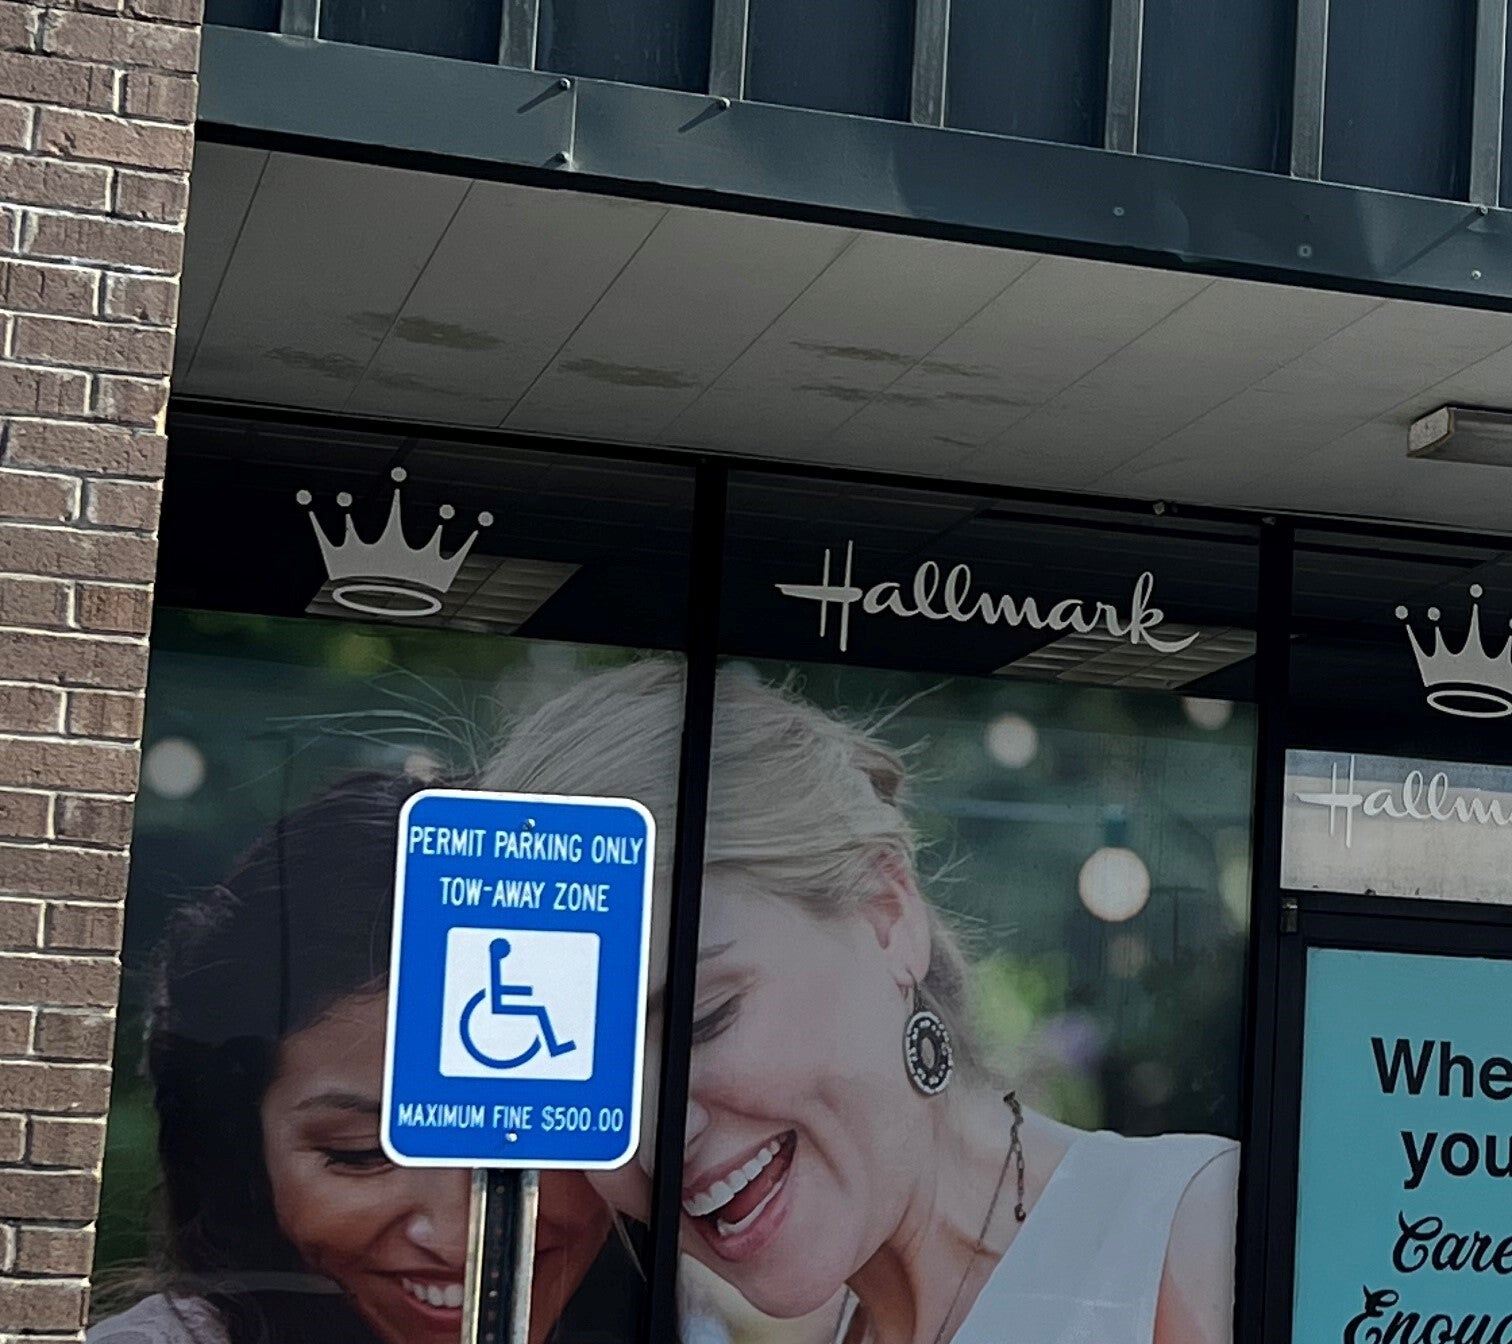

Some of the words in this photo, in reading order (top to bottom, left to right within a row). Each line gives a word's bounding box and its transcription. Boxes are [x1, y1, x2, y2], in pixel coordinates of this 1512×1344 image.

[774, 540, 1200, 652] Hallmark
[408, 825, 486, 857] PERMIT
[494, 830, 583, 863] PARKING
[590, 834, 644, 865] ONLY
[439, 877, 545, 909] TOW-AWAY
[554, 882, 611, 913] ZONE
[397, 1102, 486, 1129] MAXIMUM
[492, 1105, 533, 1131] FINE
[541, 1107, 624, 1133] $500.00
